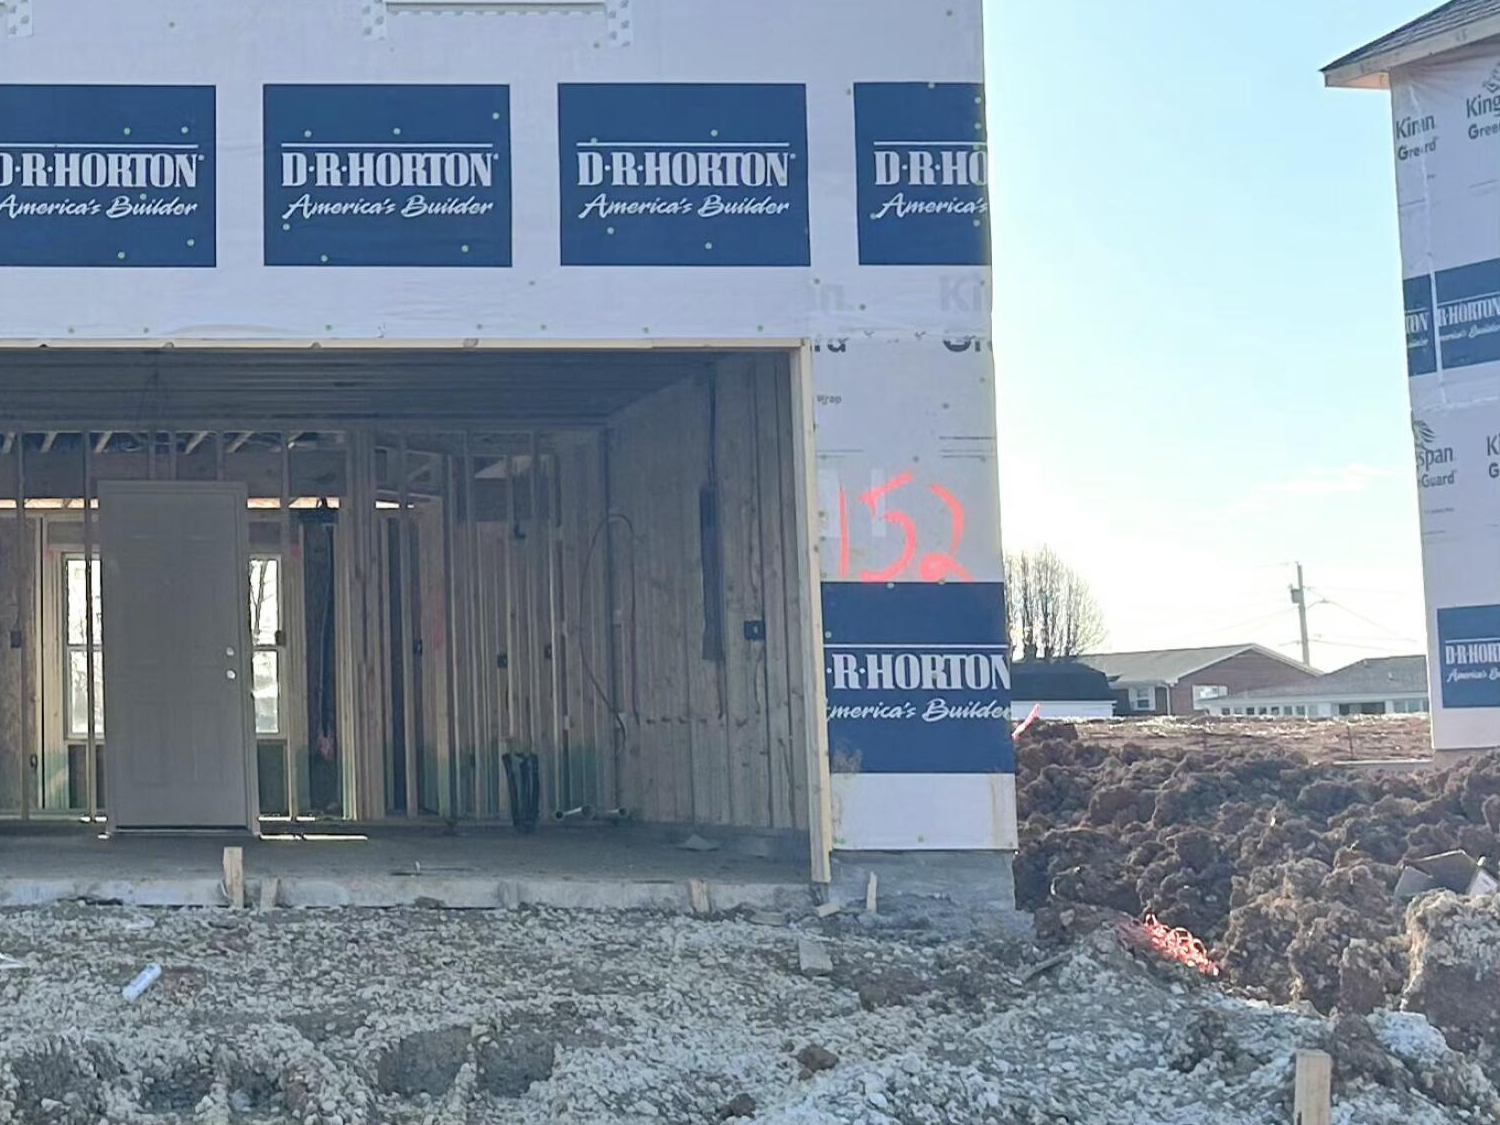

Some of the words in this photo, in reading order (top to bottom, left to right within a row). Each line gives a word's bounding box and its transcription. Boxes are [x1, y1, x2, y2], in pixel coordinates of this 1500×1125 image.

[1466, 94, 1500, 118] King
[873, 150, 988, 186] D·R·HO
[106, 195, 197, 219] Builder
[282, 194, 396, 219] America's
[400, 194, 493, 218] Builder
[578, 193, 692, 219] America's
[697, 194, 789, 218] Builder
[1419, 447, 1453, 471] span
[1421, 471, 1455, 488] Guard
[837, 472, 975, 583] 152
[826, 701, 916, 723] merica's
